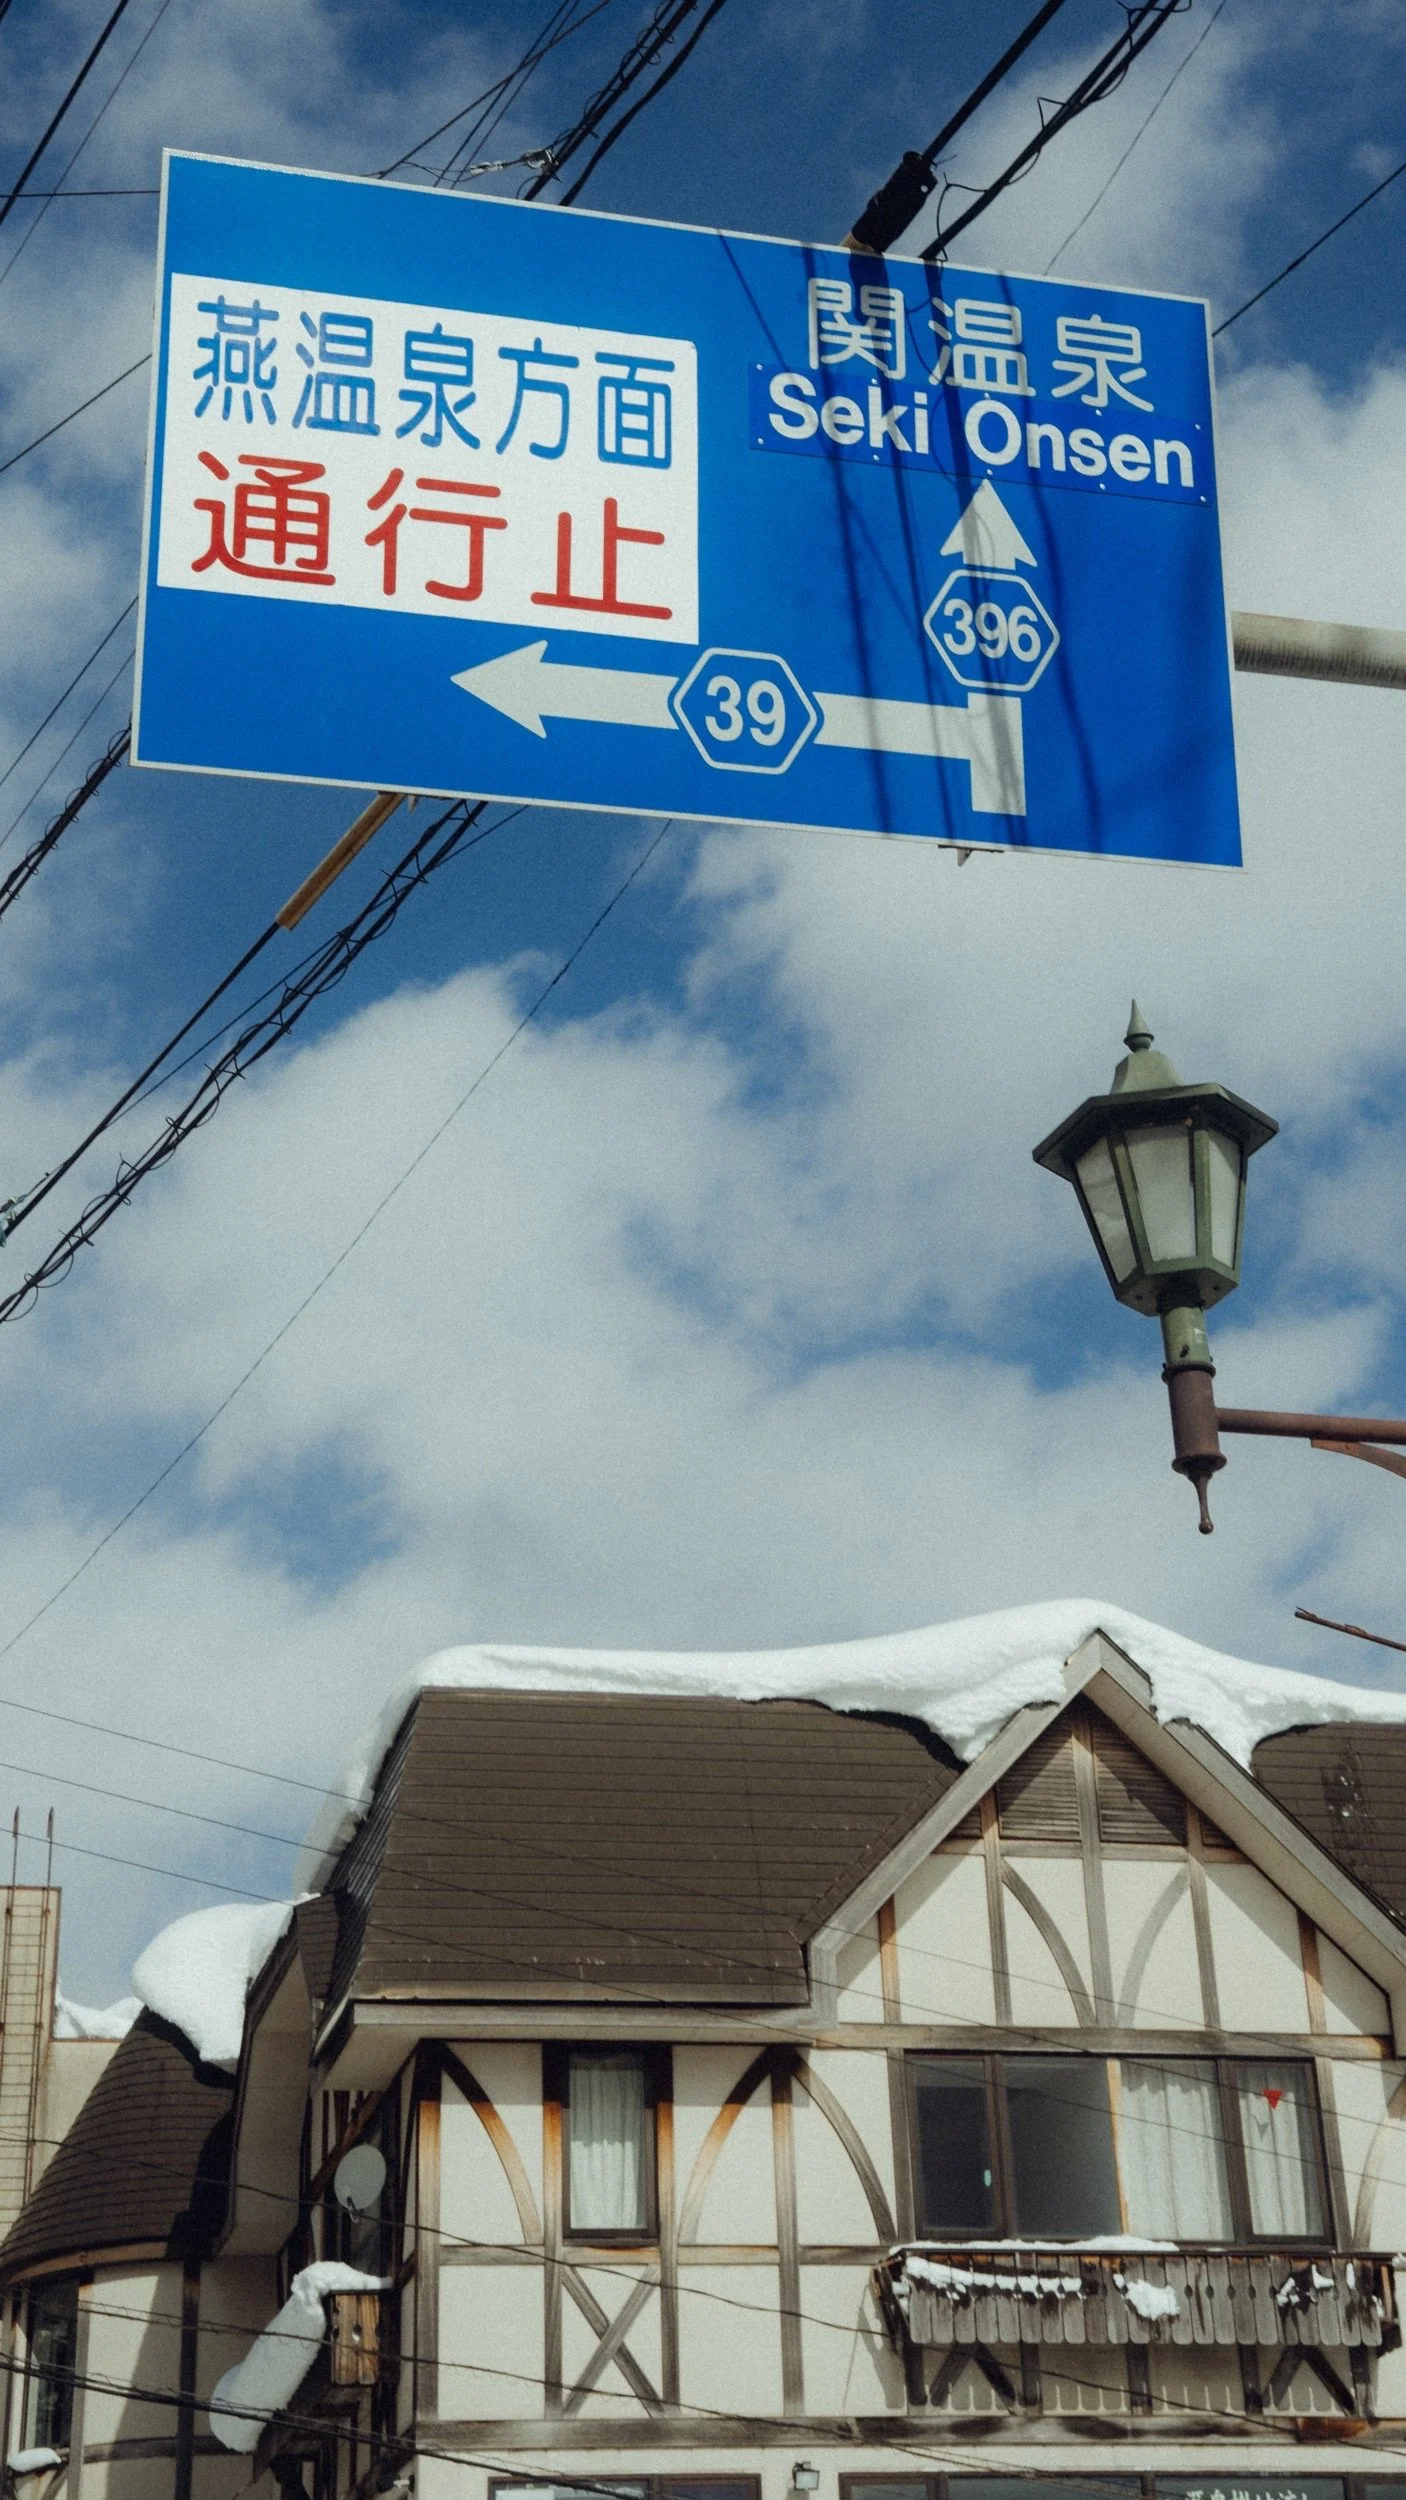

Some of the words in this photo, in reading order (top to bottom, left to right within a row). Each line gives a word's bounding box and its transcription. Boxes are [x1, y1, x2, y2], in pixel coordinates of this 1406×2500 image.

[193, 295, 678, 470] 燕温泉方面
[807, 277, 1155, 412] 関温泉
[768, 371, 930, 454] Seki
[963, 399, 1195, 488] Onsen
[191, 451, 673, 620] 通行止
[942, 598, 1042, 663] 396
[705, 674, 787, 746] 39
